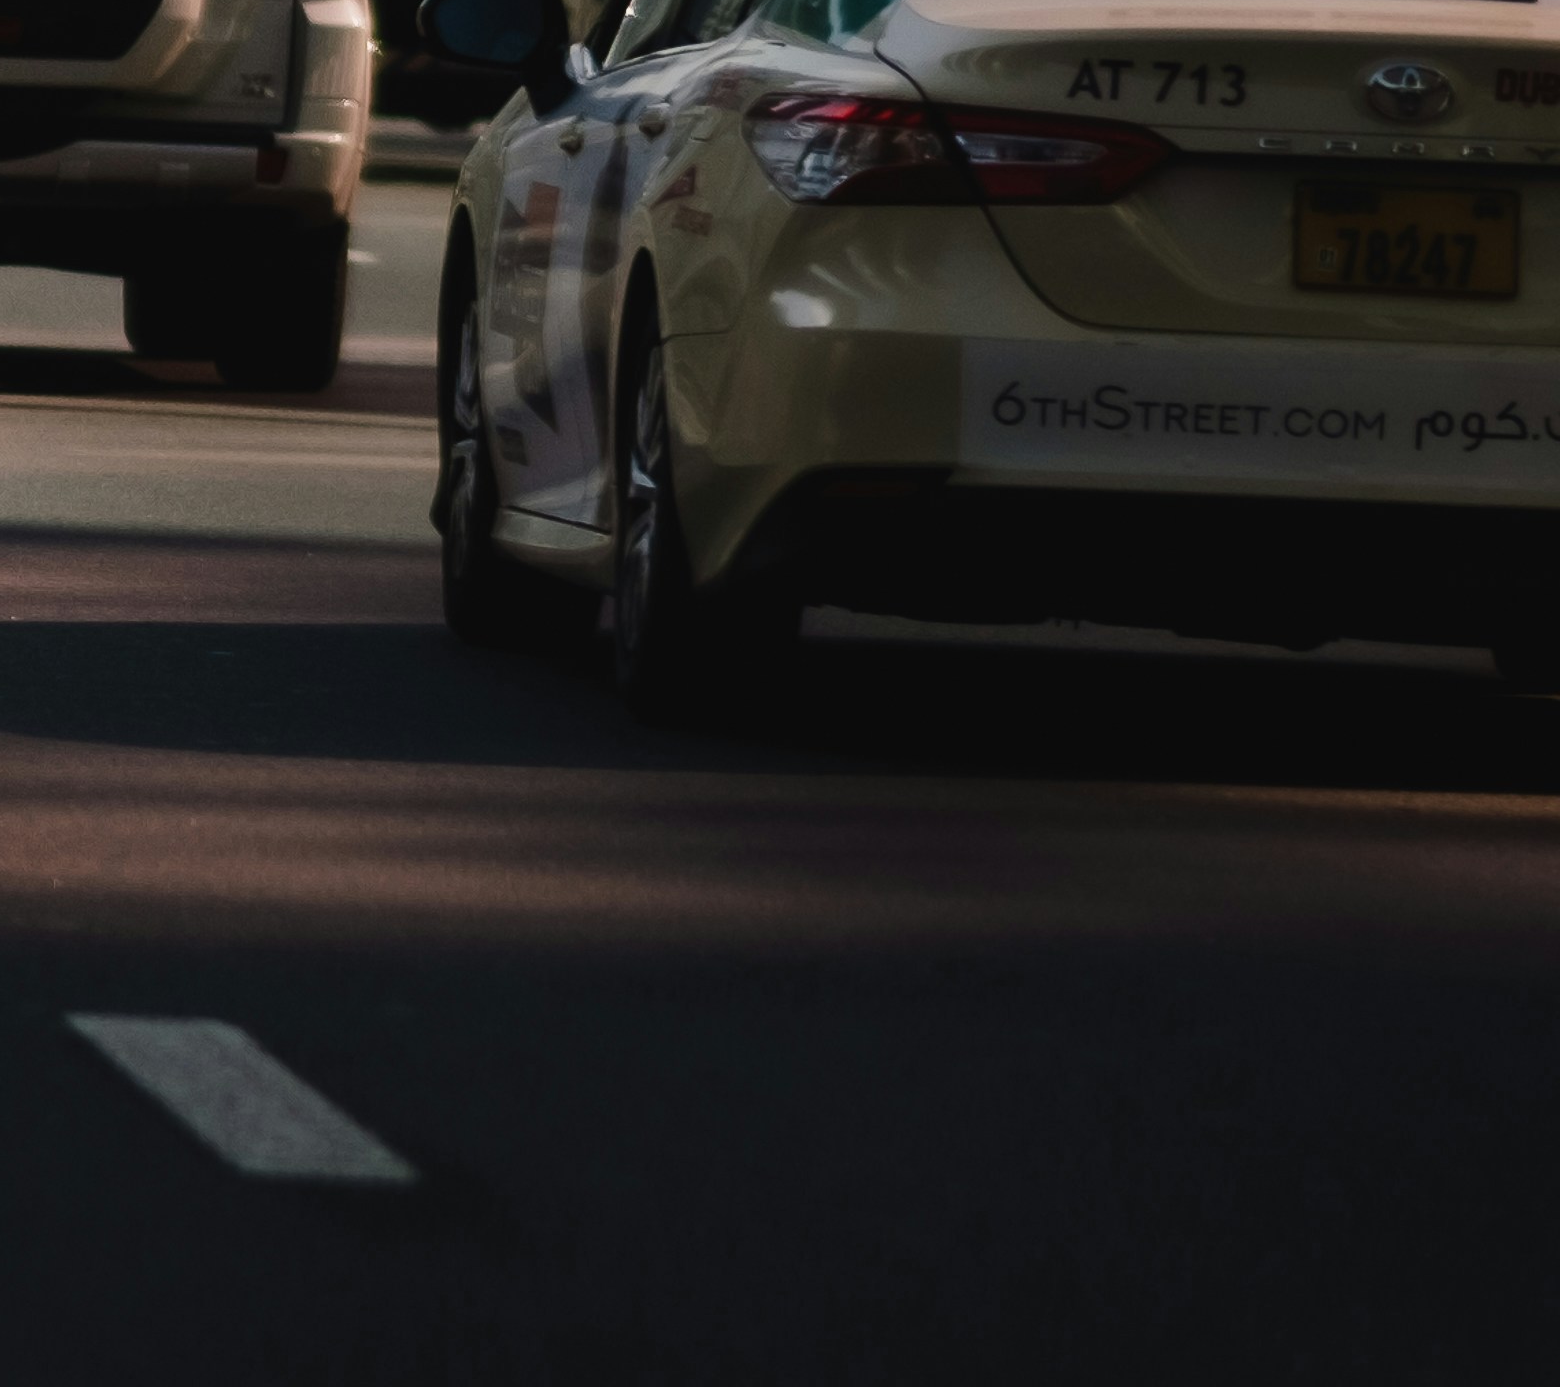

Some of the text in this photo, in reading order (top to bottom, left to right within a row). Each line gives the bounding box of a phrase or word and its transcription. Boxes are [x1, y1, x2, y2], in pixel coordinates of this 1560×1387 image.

[1067, 60, 1247, 107] AT 713
[1335, 225, 1478, 285] 78247
